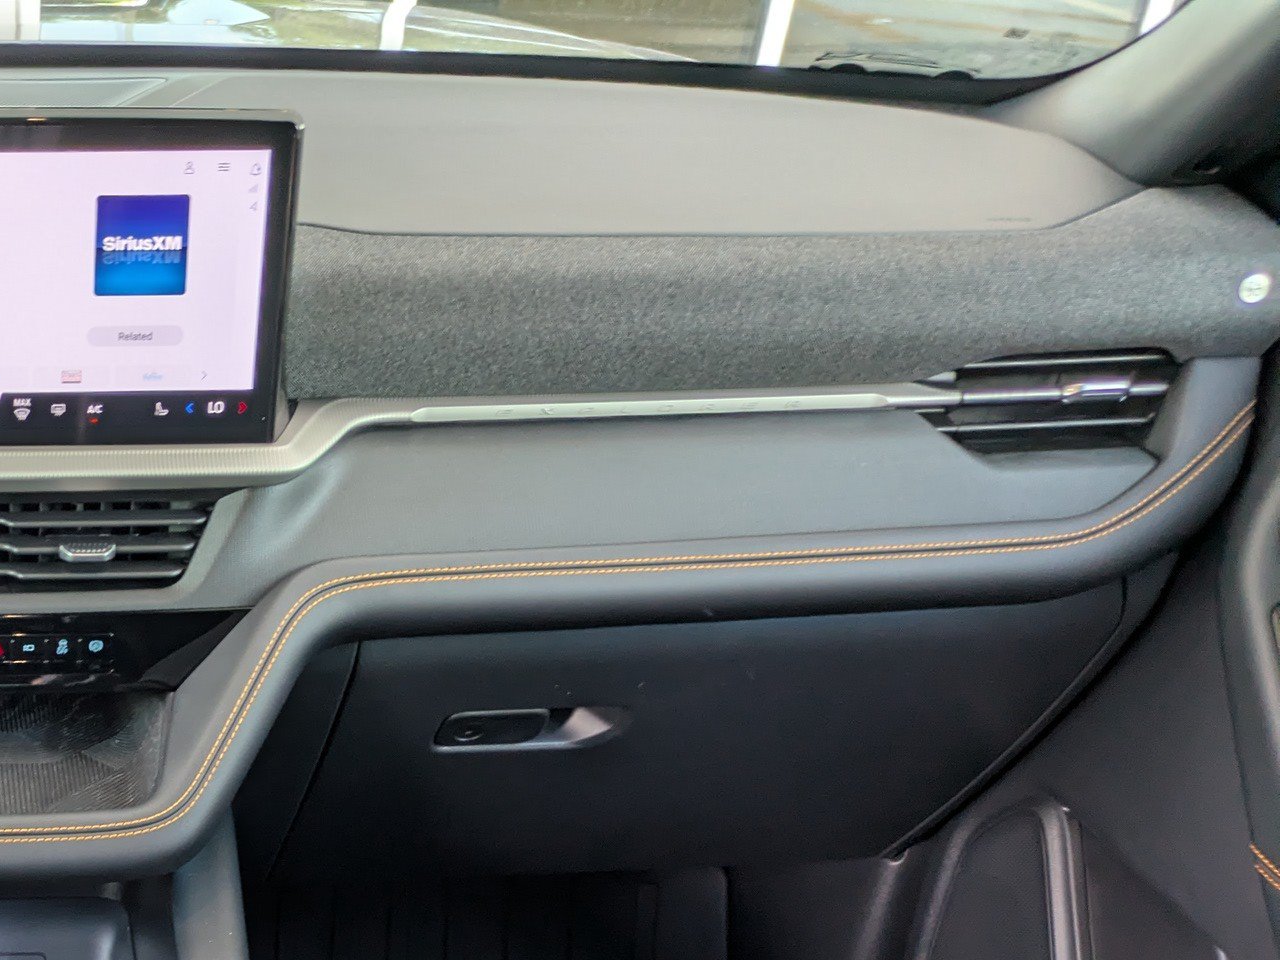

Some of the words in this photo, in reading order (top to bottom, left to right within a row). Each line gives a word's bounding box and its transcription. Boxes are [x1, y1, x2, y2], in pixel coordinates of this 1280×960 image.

[102, 235, 182, 251] SiriusXM
[118, 331, 153, 341] Related
[207, 401, 225, 415] LO
